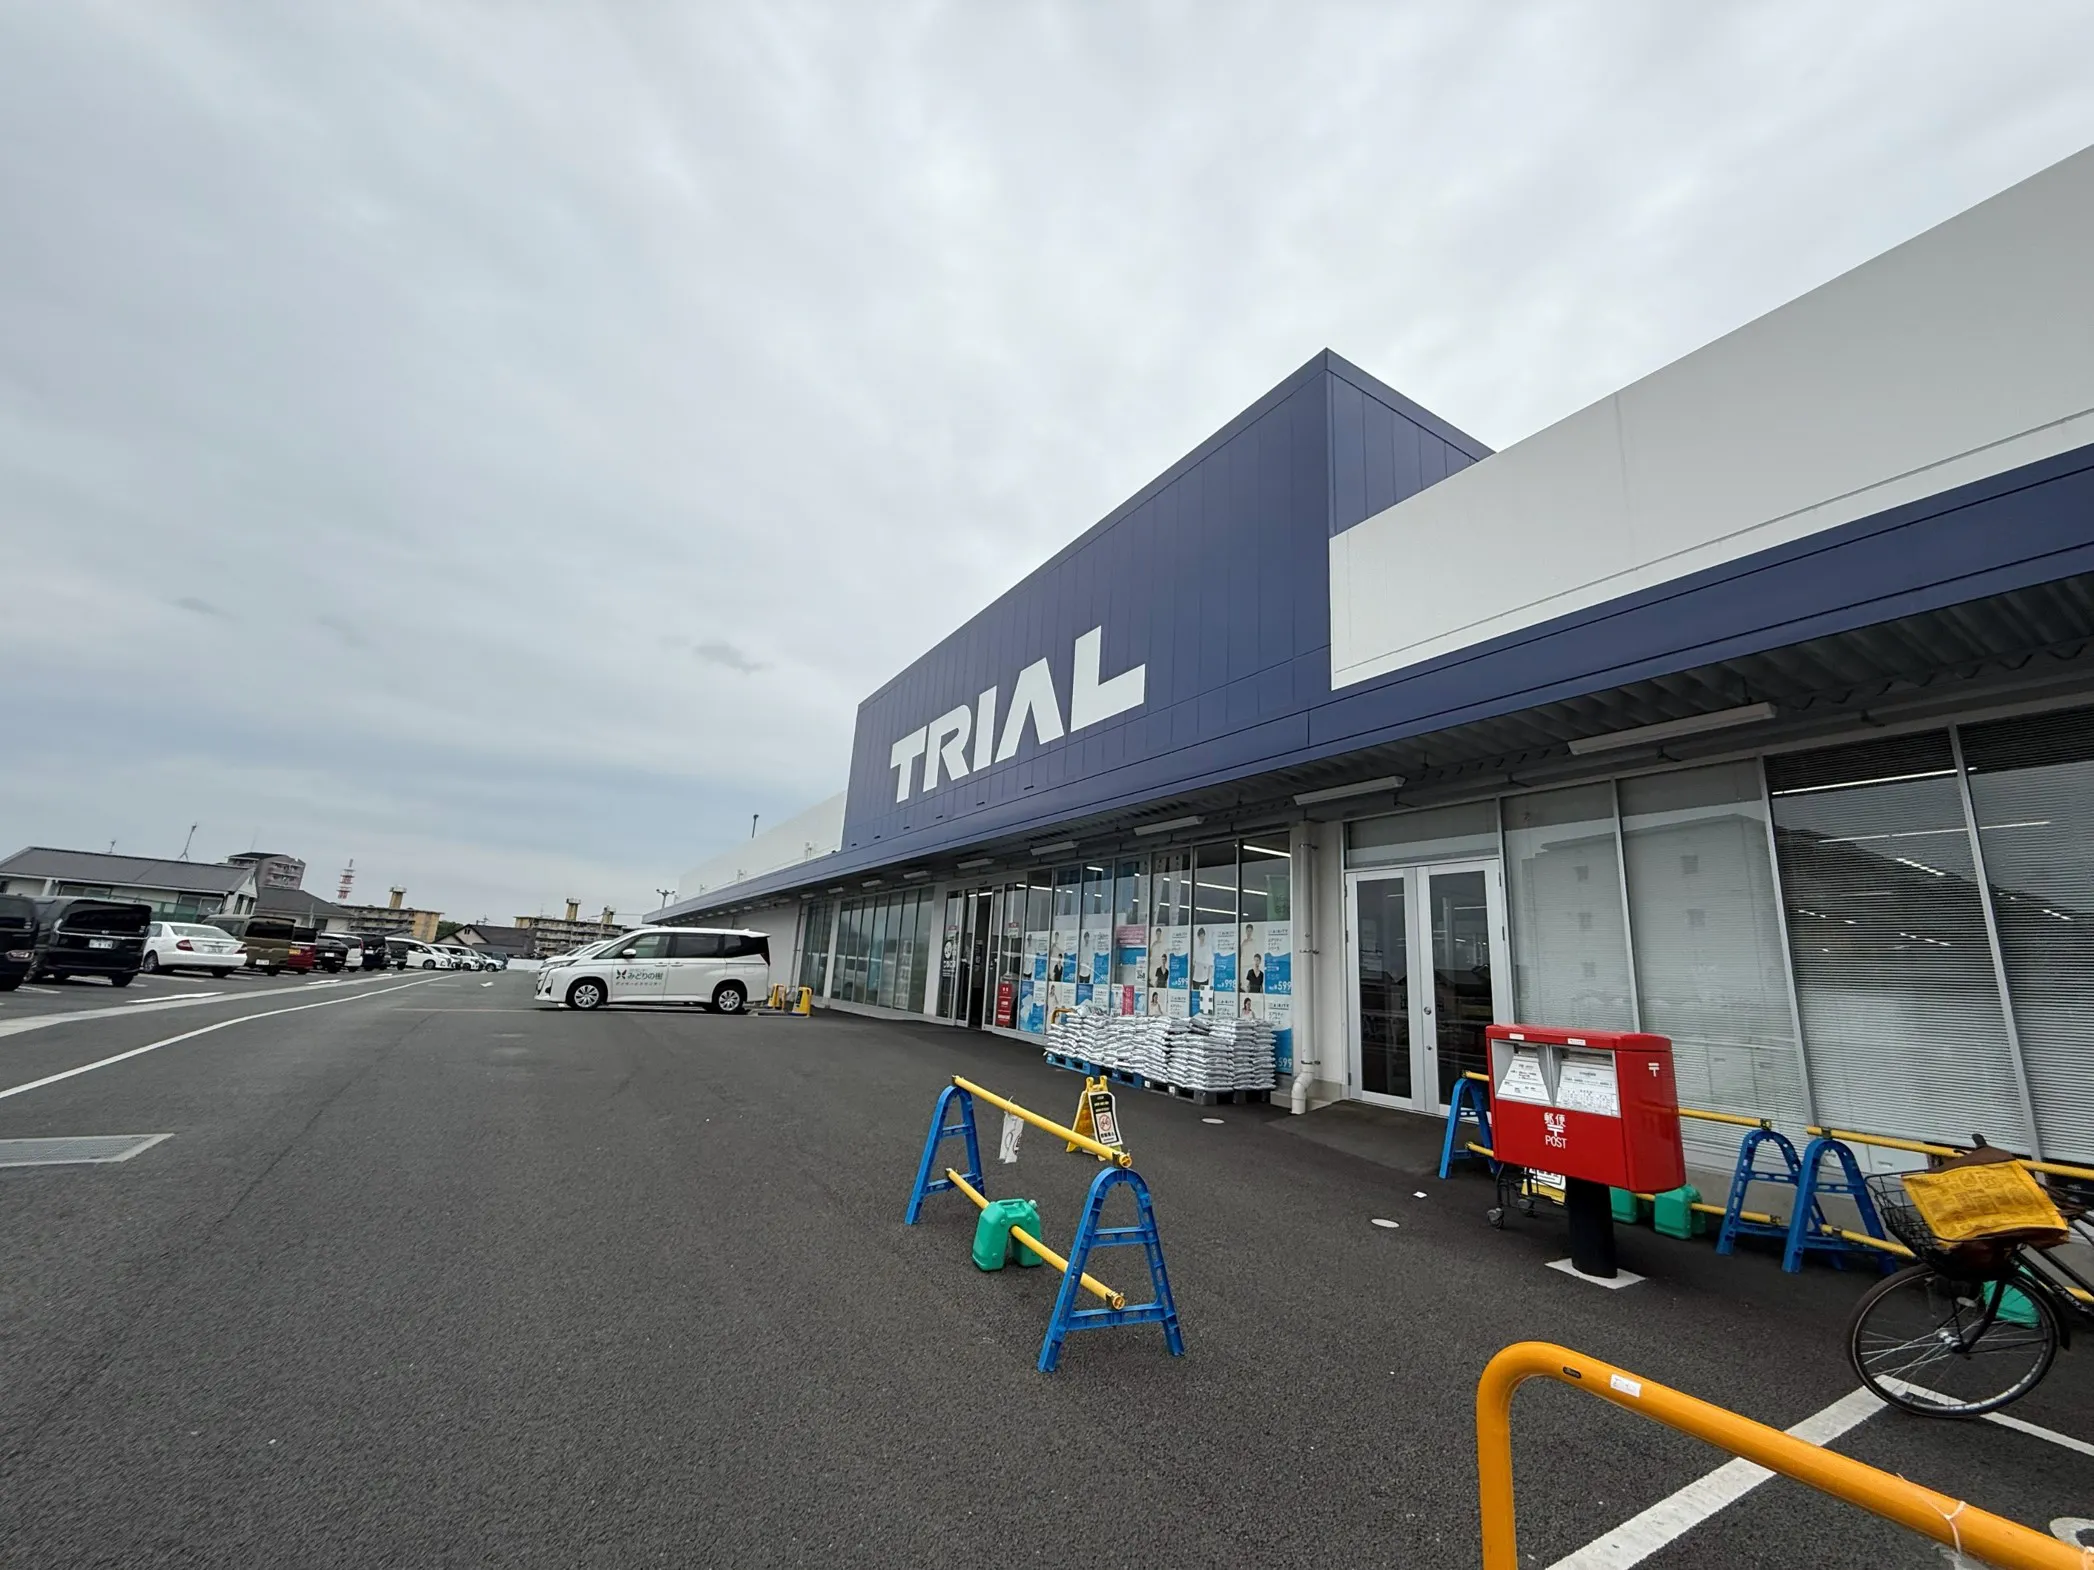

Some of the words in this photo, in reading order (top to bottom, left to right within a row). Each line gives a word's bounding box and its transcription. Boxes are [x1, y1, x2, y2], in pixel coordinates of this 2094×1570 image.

[890, 626, 1146, 804] TRIAL
[1277, 980, 1292, 991] 599
[1278, 1057, 1292, 1068] 599
[1544, 1112, 1566, 1127] 郵便
[1545, 1135, 1567, 1149] POST
